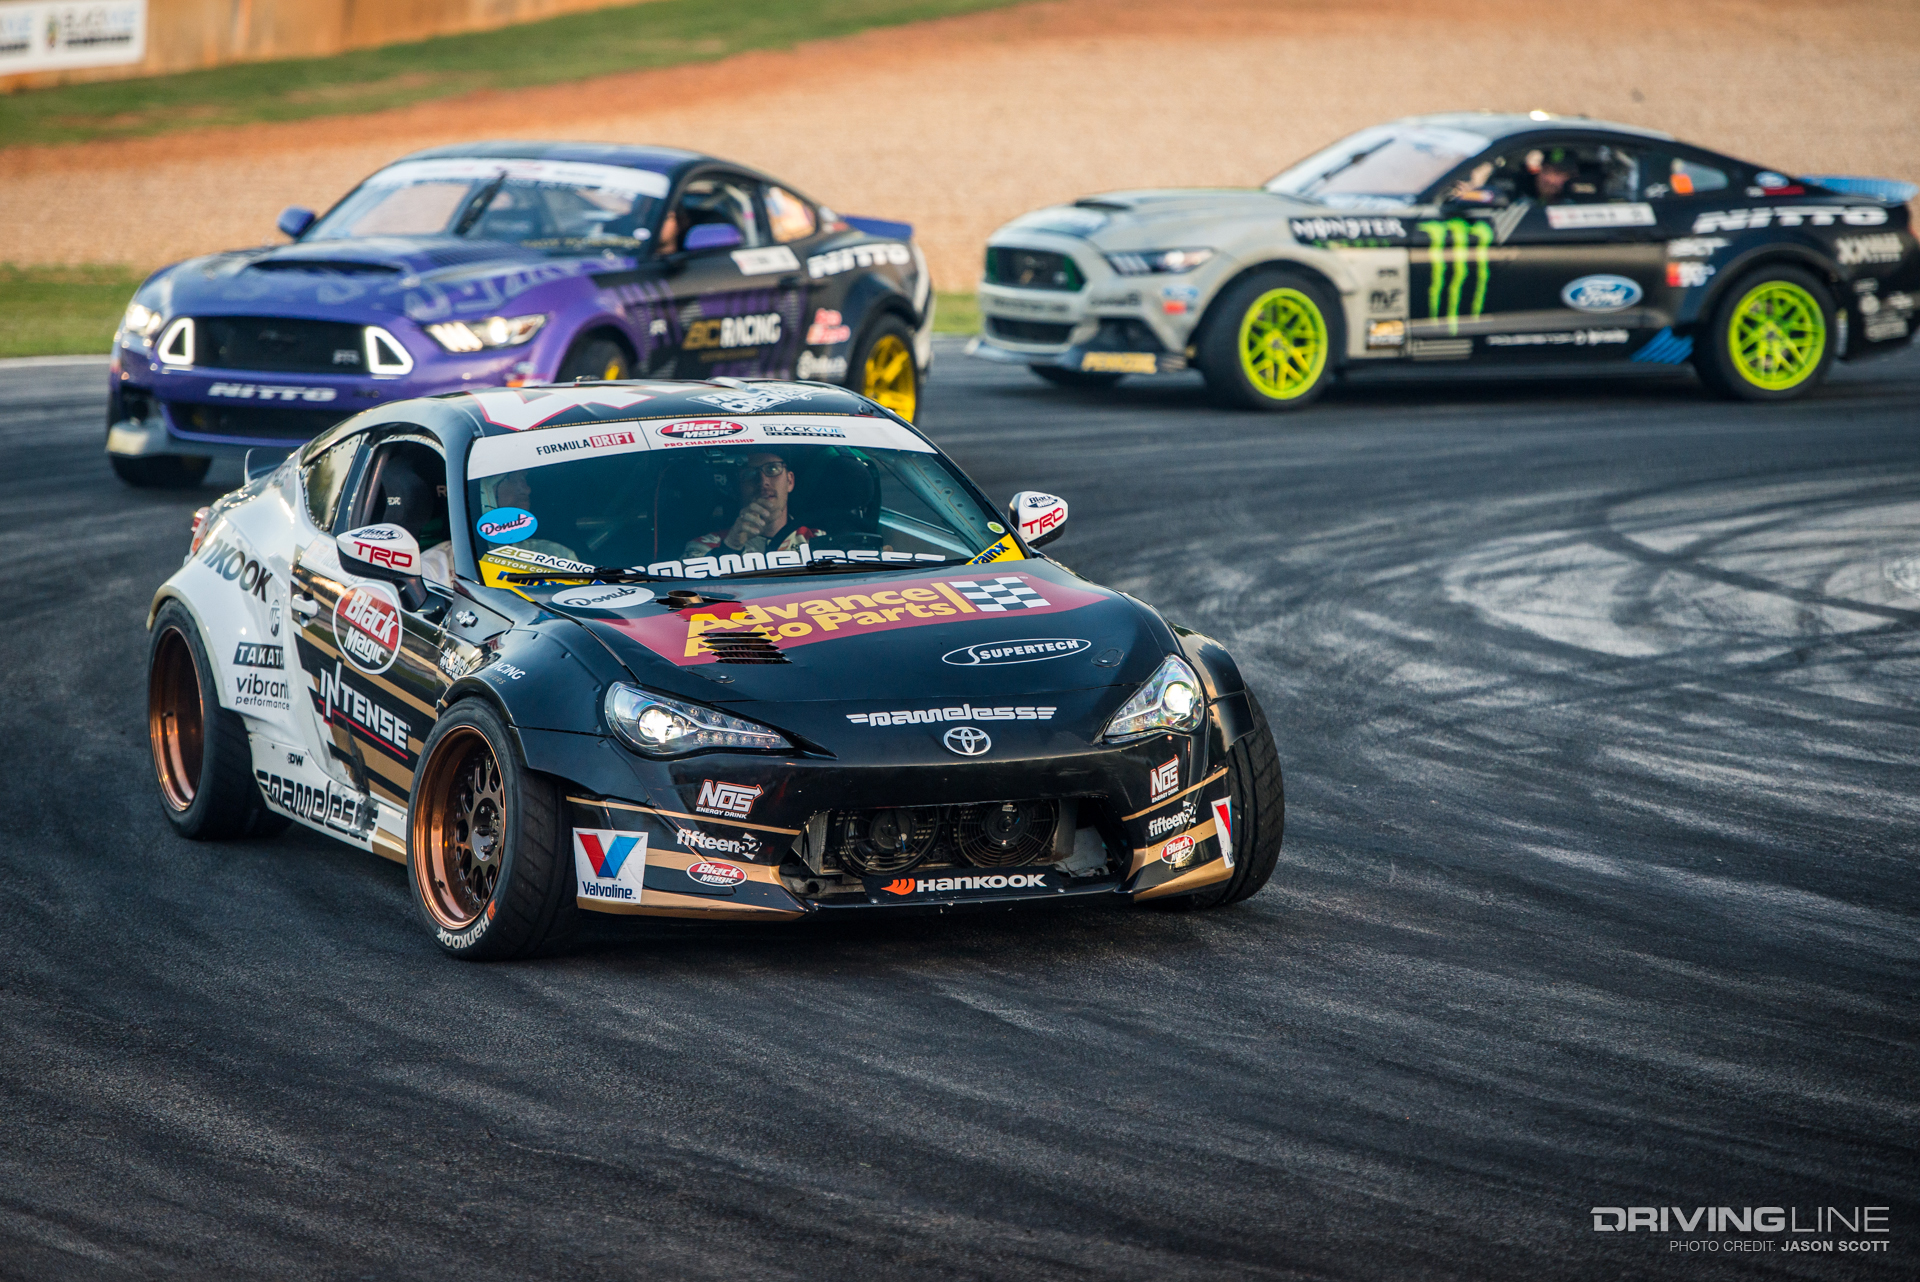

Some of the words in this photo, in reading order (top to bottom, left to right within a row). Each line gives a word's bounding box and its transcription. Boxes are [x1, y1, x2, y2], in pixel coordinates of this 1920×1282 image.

[1692, 205, 1889, 234] NITTO
[807, 243, 911, 278] NITTO
[720, 313, 782, 348] RACING
[208, 382, 337, 402] NITTO
[672, 422, 734, 433] Black
[682, 429, 735, 439] Magic
[536, 439, 591, 456] FORMULA
[590, 432, 634, 448] DRIFT
[685, 438, 755, 446] CHAMPIONSHIP
[480, 513, 535, 535] Donut
[1022, 507, 1065, 535] TRD
[353, 541, 413, 568] TRD
[487, 556, 528, 570] CUSTOM
[534, 554, 596, 574] RACING
[564, 587, 638, 607] Donut
[344, 588, 398, 644] Black
[688, 582, 940, 638] Advance
[683, 621, 813, 657] Ato
[811, 599, 957, 632] Parts
[343, 625, 389, 666] Magic
[979, 640, 1080, 660] SUPERTECH
[235, 695, 290, 711] performance
[320, 660, 409, 751] INTENSE
[1151, 756, 1179, 797] NOS
[698, 780, 763, 814] NOS
[696, 806, 724, 817] ENERGY
[724, 811, 748, 820] DRINK
[1166, 837, 1191, 856] Black
[697, 863, 740, 878] Black
[700, 874, 737, 885] Magic
[582, 880, 633, 900] Valvoline
